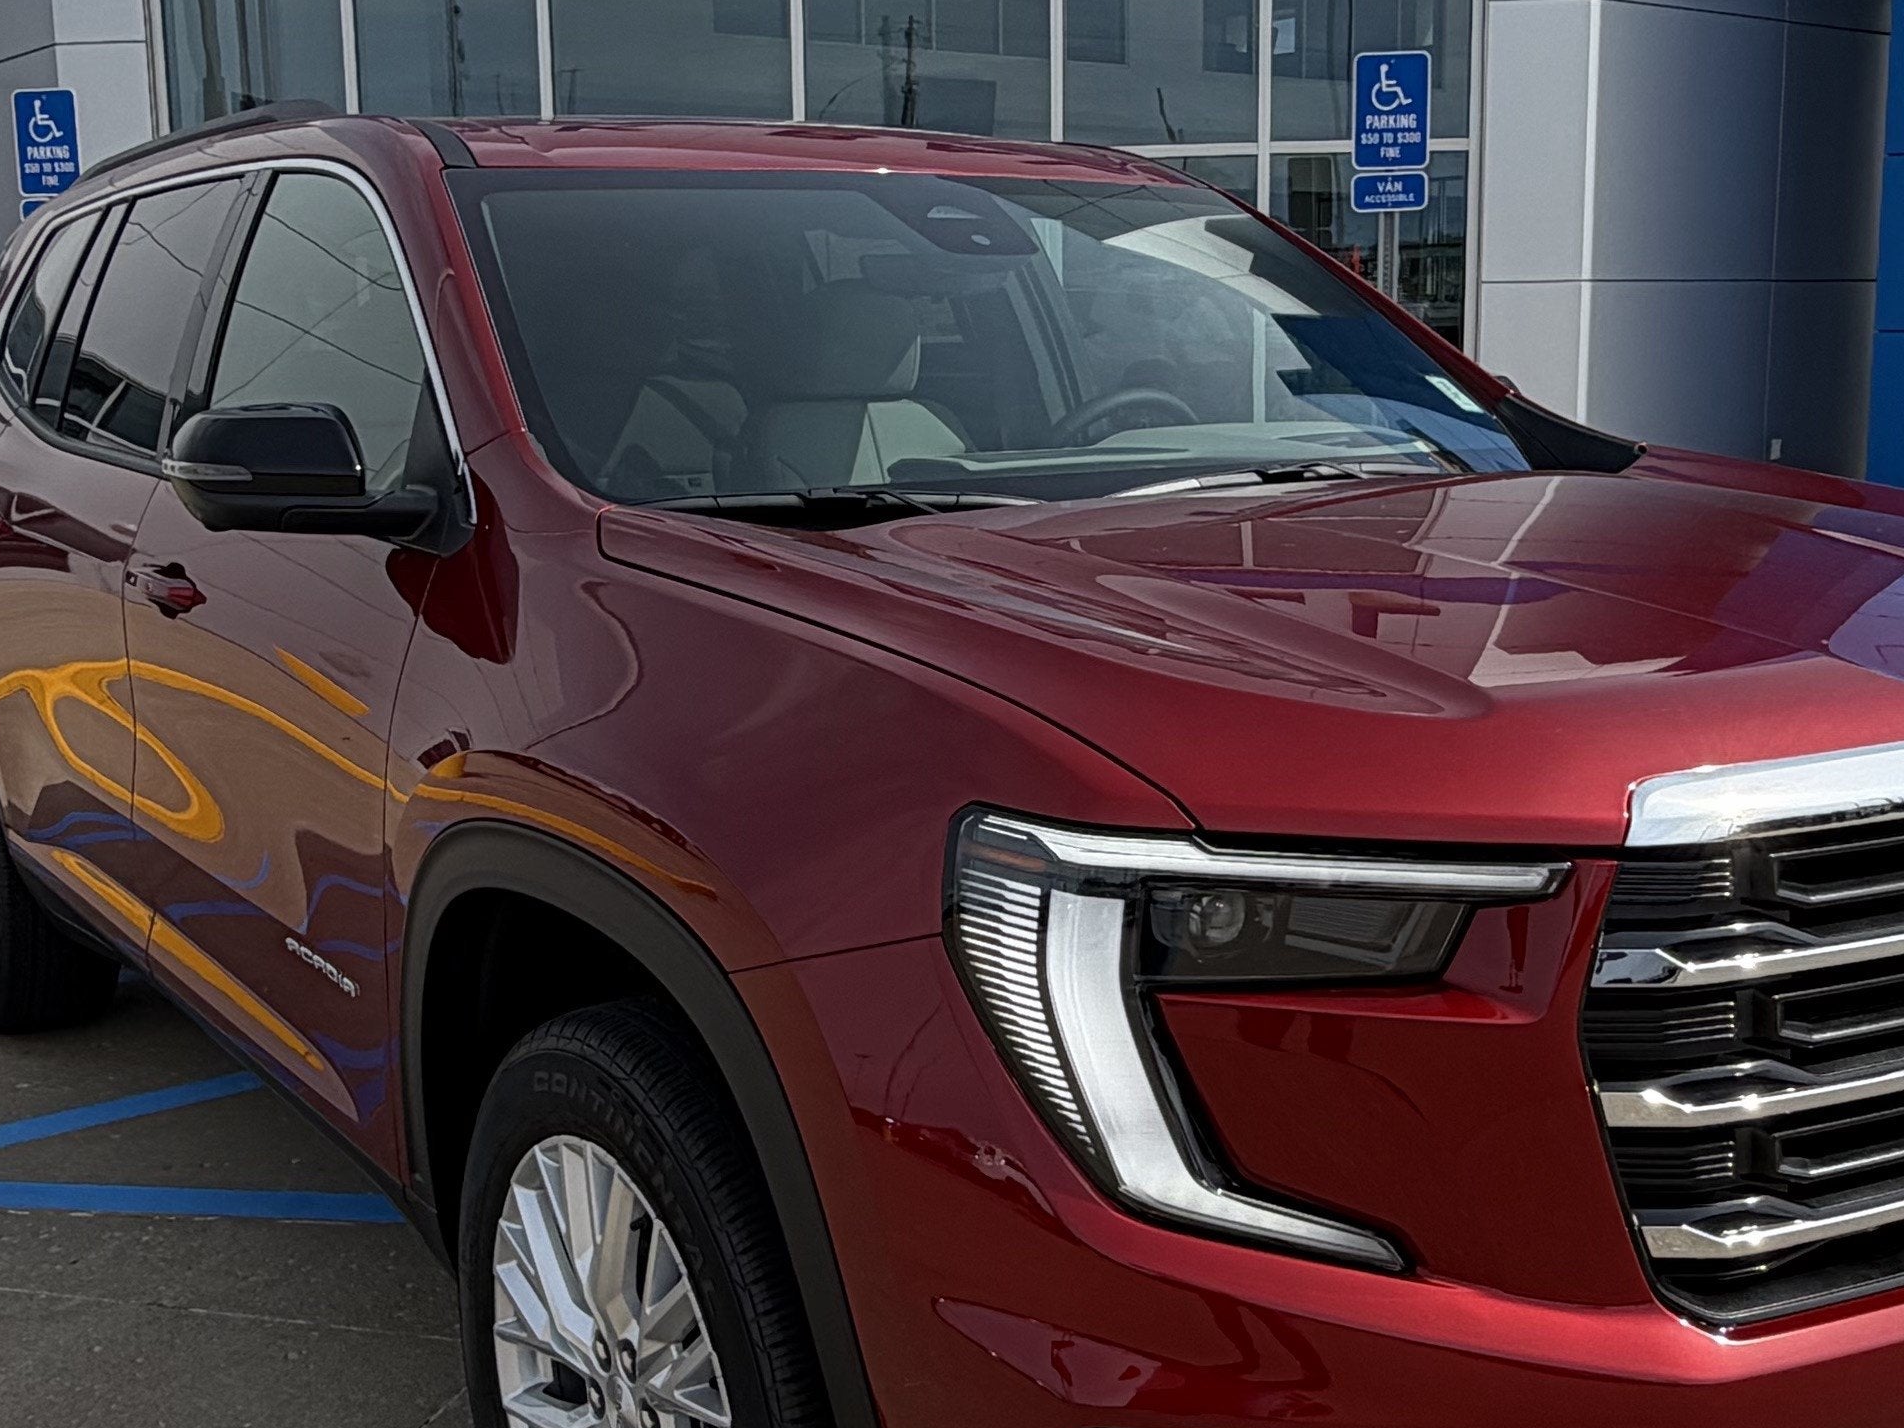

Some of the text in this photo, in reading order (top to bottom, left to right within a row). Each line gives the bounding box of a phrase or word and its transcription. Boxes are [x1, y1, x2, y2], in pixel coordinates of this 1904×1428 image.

[1365, 114, 1418, 130] PARKING
[1383, 132, 1394, 144] TO
[26, 145, 71, 161] PARKING
[1380, 146, 1402, 159] FINE
[1376, 180, 1403, 194] VAN
[532, 1070, 718, 1320] CONTINENTAL
